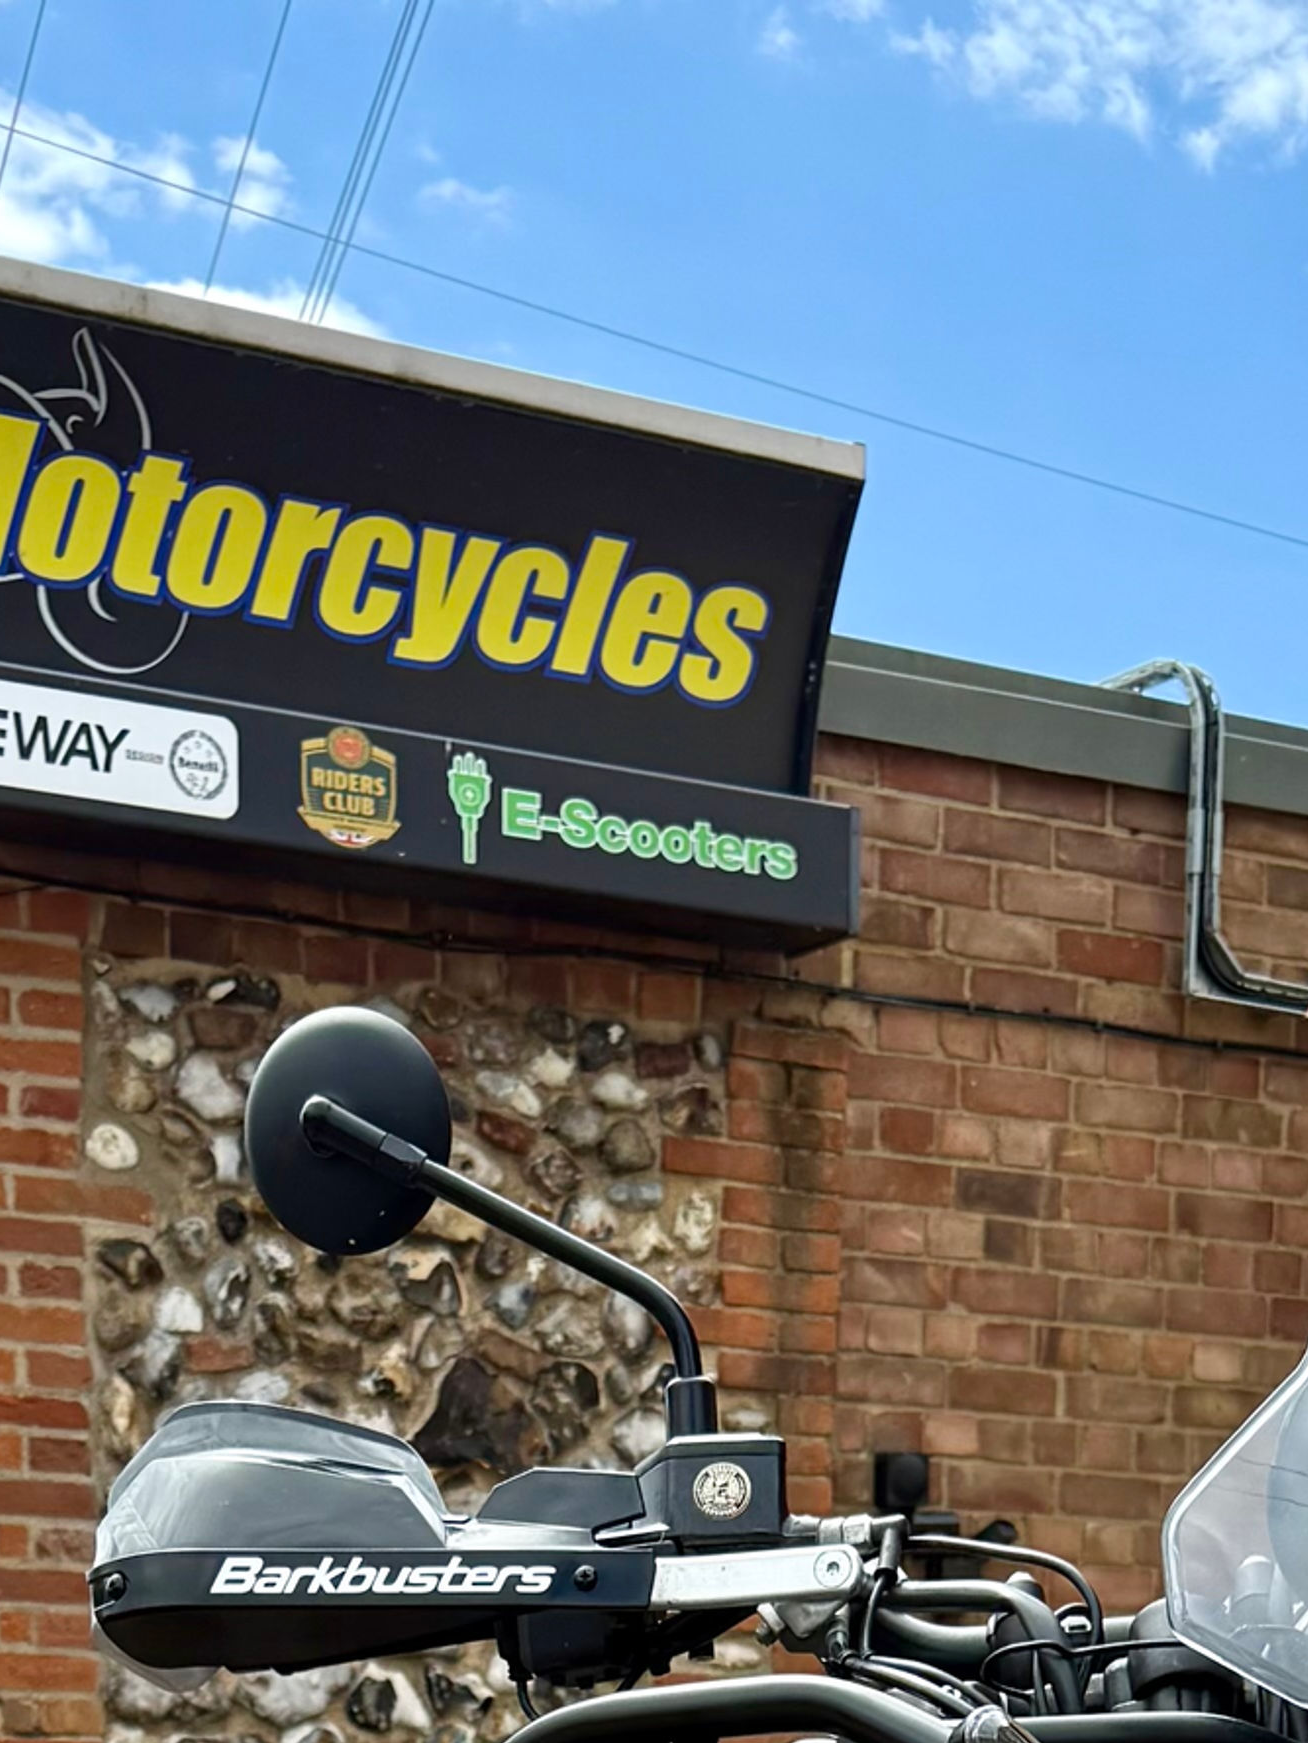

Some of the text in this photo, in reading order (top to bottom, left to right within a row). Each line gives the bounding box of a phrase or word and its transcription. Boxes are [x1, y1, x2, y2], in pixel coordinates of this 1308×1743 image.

[311, 767, 387, 797] RIDERS
[323, 791, 376, 816] CLUB
[501, 787, 798, 880] E-Scooters
[209, 1556, 556, 1595] Barkbusters
